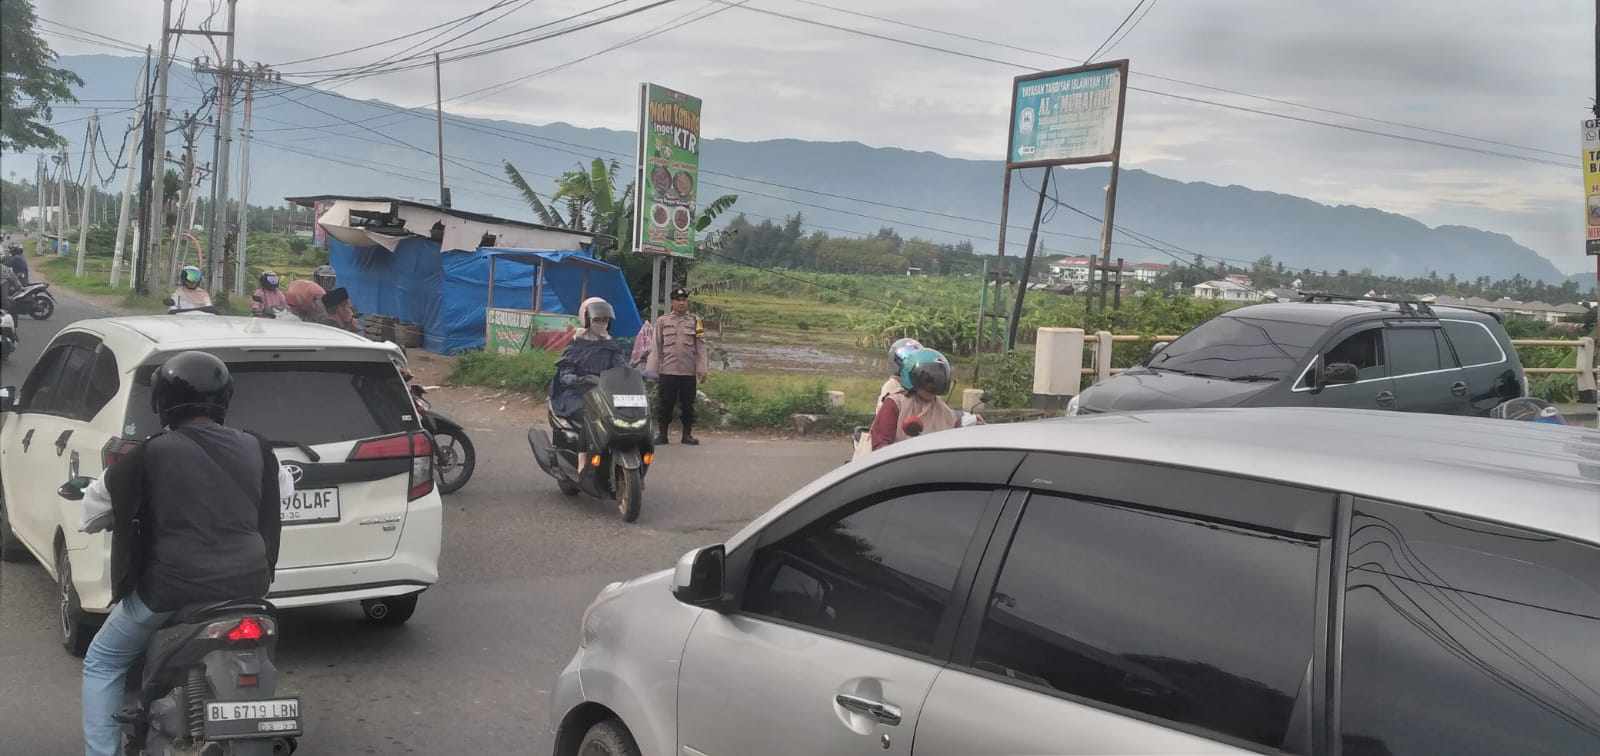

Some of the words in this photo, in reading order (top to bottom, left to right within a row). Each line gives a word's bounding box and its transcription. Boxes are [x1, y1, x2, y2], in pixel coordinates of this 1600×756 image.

[674, 127, 696, 153] KTR
[212, 706, 228, 720] BL
[234, 704, 267, 719] 6719
[272, 703, 296, 718] LBN
